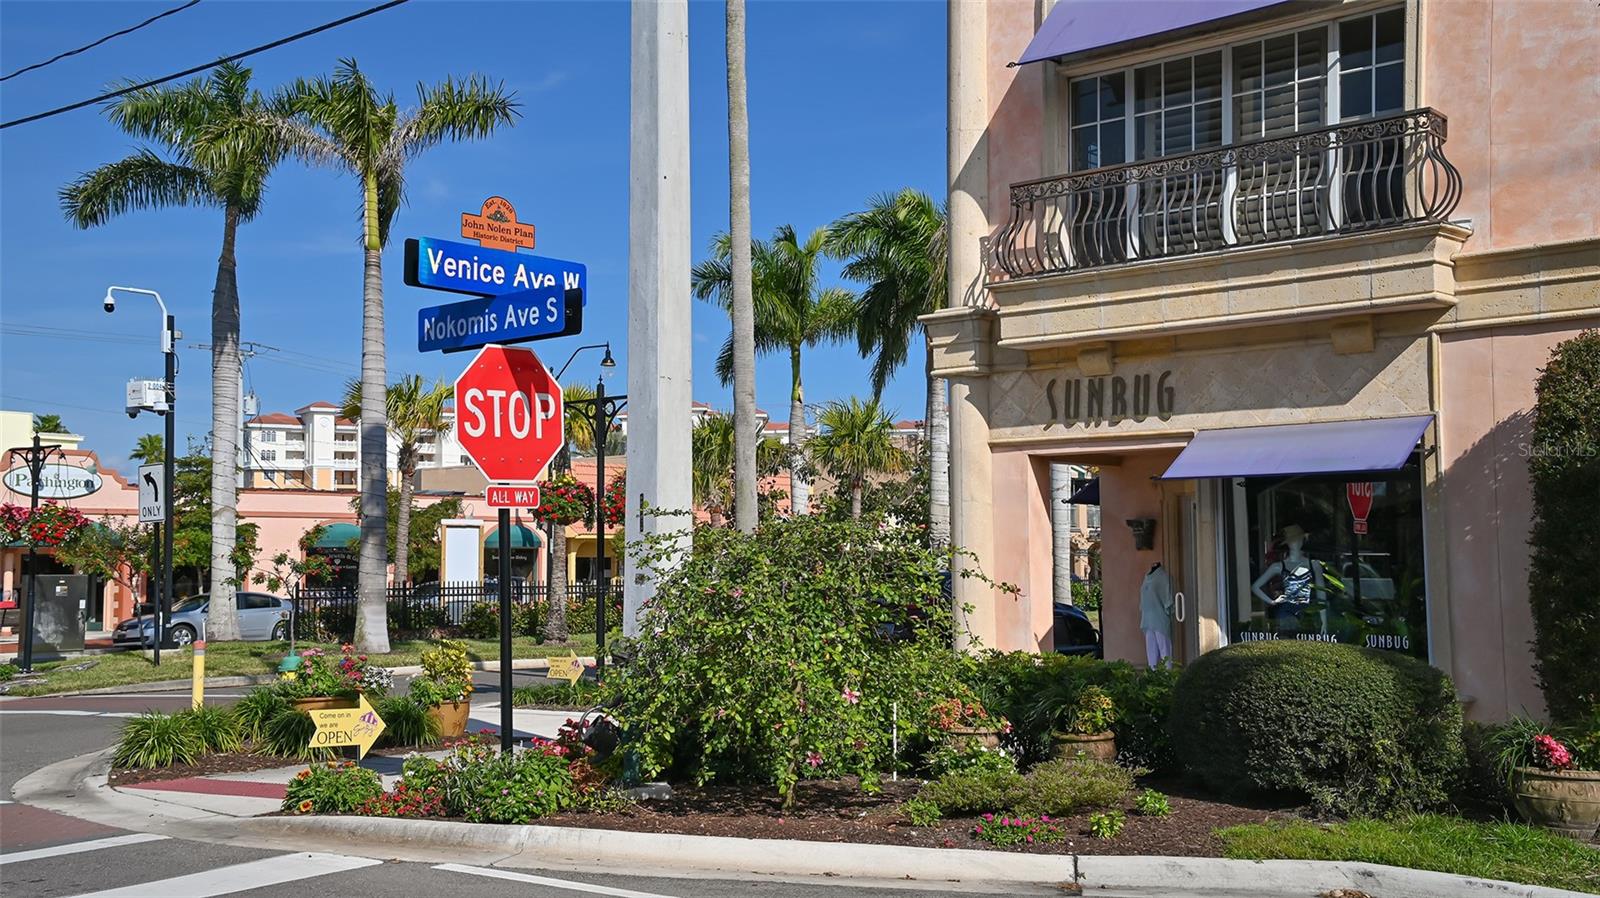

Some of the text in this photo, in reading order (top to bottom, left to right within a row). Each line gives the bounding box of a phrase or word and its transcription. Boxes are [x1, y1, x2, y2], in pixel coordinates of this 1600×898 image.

[463, 219, 533, 238] John Nolen Plan
[473, 231, 523, 245] Historic District
[428, 248, 579, 290] Venice Ave W
[424, 297, 557, 341] Nokomis Ave S
[1046, 370, 1175, 427] SUNBUG
[464, 388, 556, 439] STOP
[492, 491, 534, 504] ALL WAY
[143, 505, 161, 517] ONLY
[1365, 634, 1409, 649] SUNBUG
[550, 669, 567, 677] OPEN
[317, 730, 353, 744] OPEN
